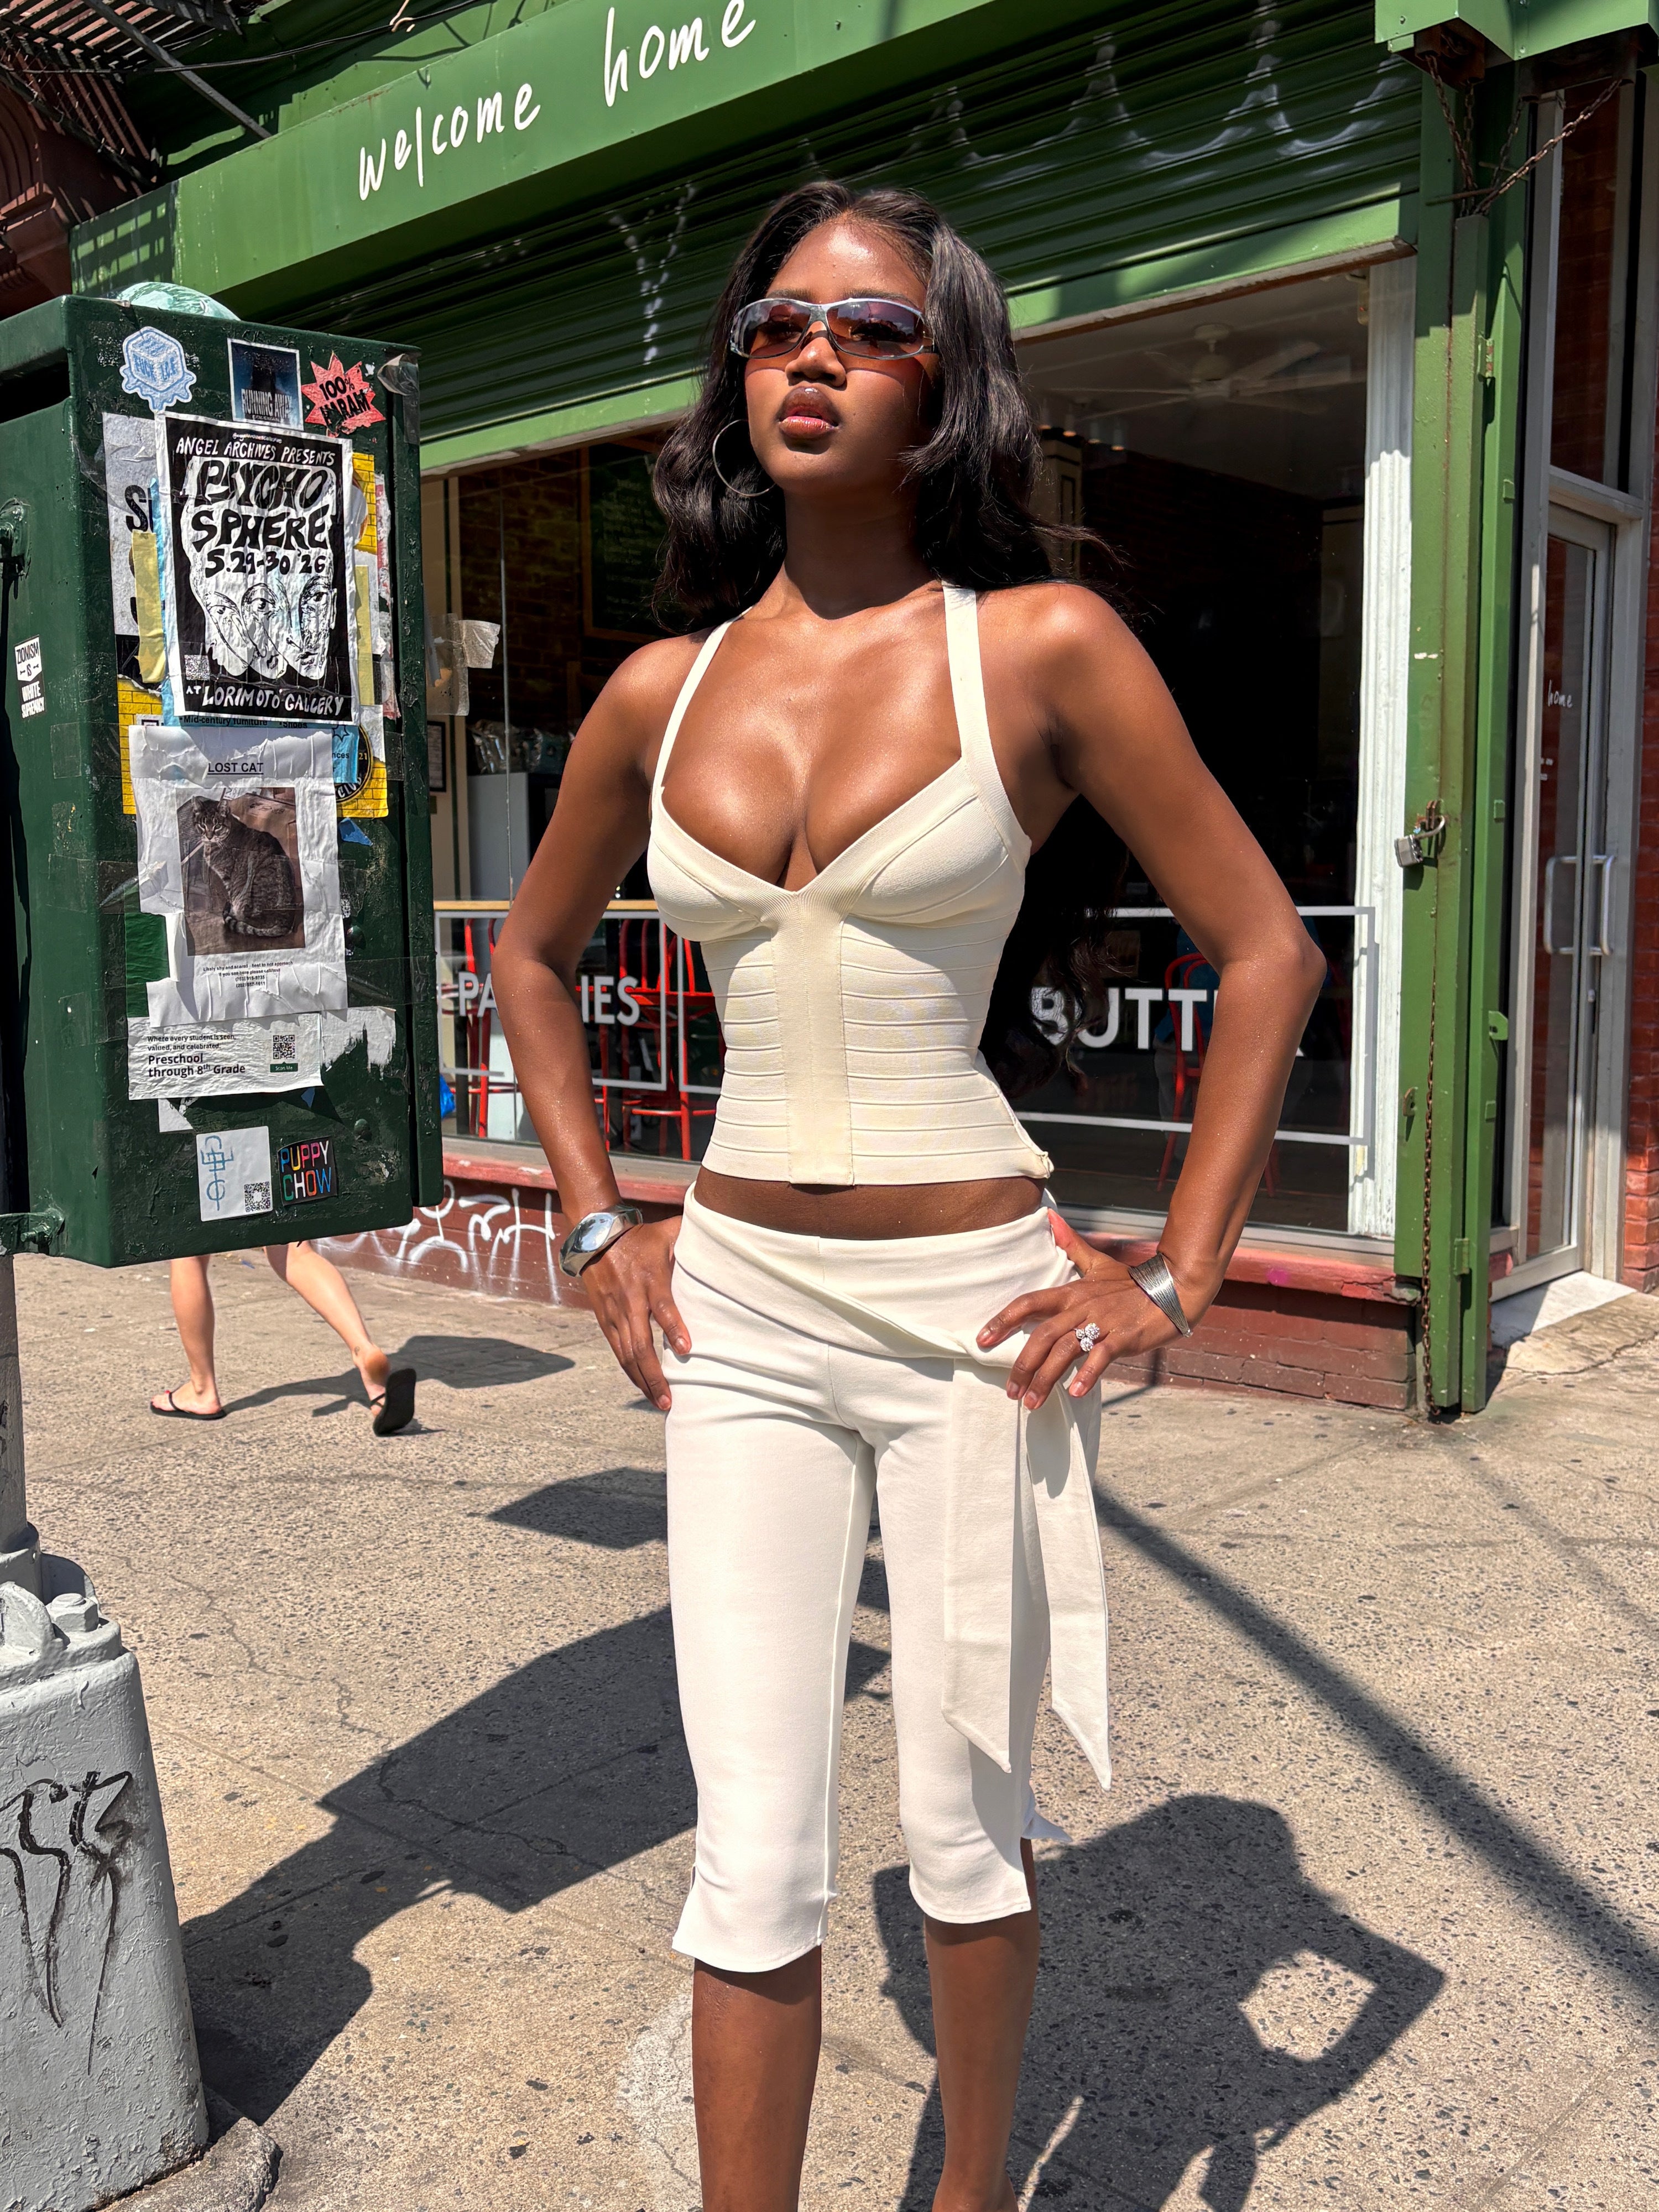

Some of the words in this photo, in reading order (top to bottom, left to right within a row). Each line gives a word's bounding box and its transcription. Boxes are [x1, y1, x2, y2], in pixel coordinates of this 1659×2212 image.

[359, 83, 541, 201] welcome
[603, 0, 757, 107] home
[319, 376, 355, 401] 100%
[241, 389, 273, 416] RUNNING
[275, 393, 292, 419] AWAY
[176, 436, 219, 455] ANGEL
[224, 441, 276, 461] ARCHIVES
[280, 446, 336, 466] PRESENTS
[194, 460, 328, 511] PSYCHO
[191, 504, 330, 552] SPHERE
[16, 641, 39, 664] ZIONISM
[27, 664, 32, 677] IS
[22, 681, 41, 702] WHITE
[186, 686, 201, 695] AT
[202, 686, 280, 709] LORIMOTO
[284, 695, 344, 716] GALLERY
[1547, 679, 1573, 708] home
[21, 696, 44, 718] SUPREMACY
[208, 762, 238, 773] LOST
[241, 762, 264, 773] CAT
[458, 971, 641, 1026] PAIES
[148, 1053, 204, 1065] Preschool
[148, 1066, 194, 1078] through
[197, 1063, 211, 1075] 8th
[213, 1064, 246, 1074] Grade
[280, 1140, 329, 1173] PUPPY
[283, 1167, 332, 1201] CHOW
